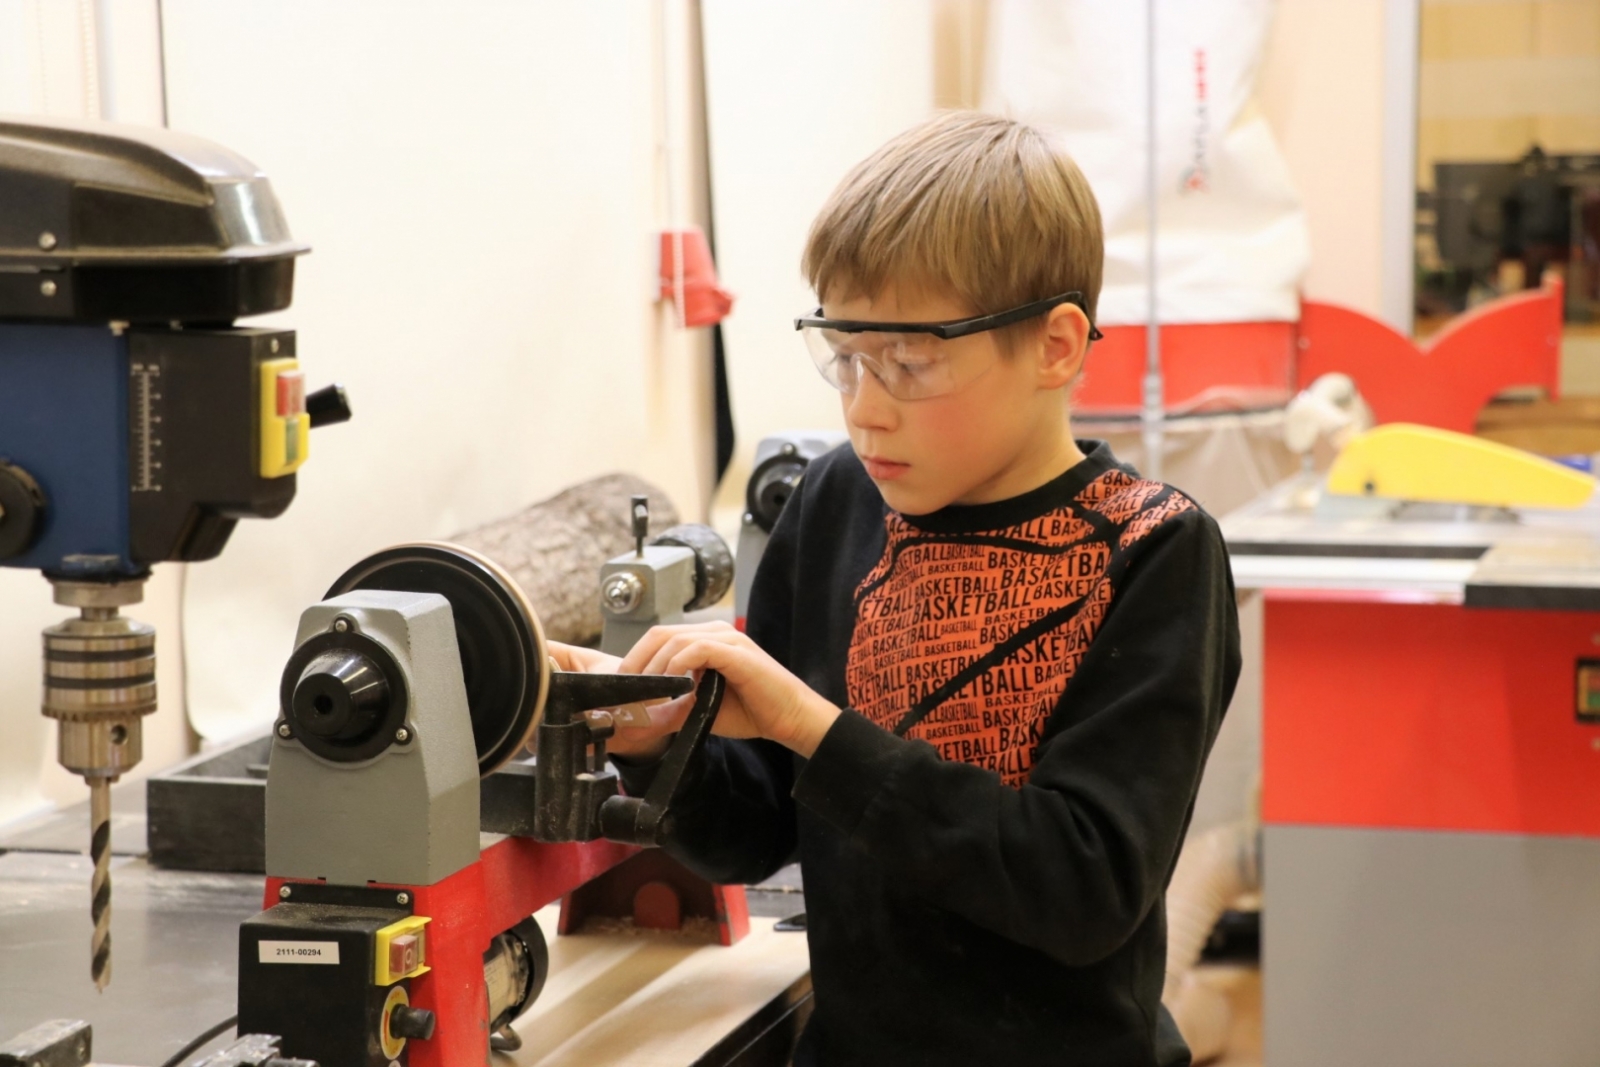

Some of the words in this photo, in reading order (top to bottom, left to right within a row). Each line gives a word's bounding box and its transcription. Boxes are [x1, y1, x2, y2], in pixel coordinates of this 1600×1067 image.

[928, 561, 985, 575] BASKETBALL
[915, 576, 998, 600] BASKETBALL
[914, 587, 1031, 624] BASKETBALL
[873, 623, 941, 657] BASKETBALL
[925, 639, 978, 656] BASKETBALL
[926, 722, 982, 740] BASKETBALL
[276, 948, 321, 956] 2111-00294
